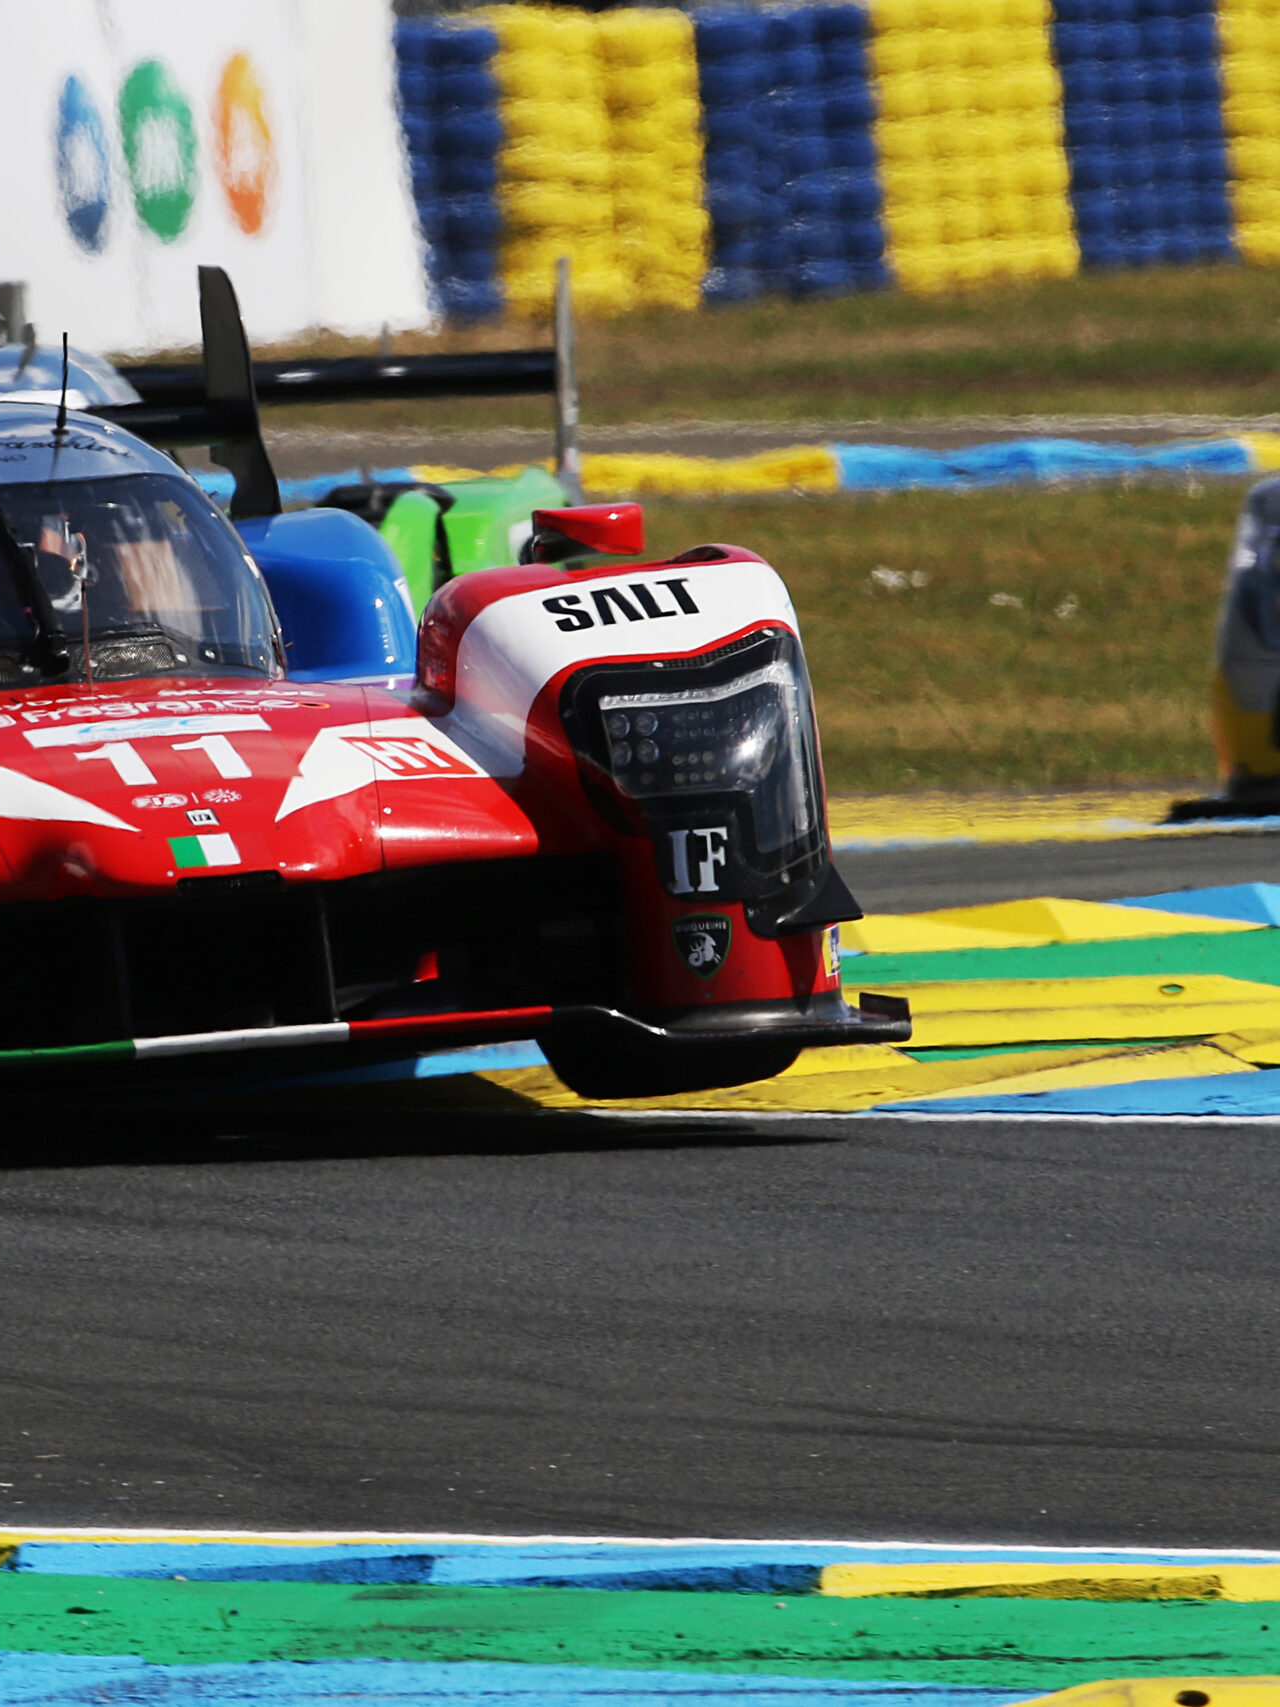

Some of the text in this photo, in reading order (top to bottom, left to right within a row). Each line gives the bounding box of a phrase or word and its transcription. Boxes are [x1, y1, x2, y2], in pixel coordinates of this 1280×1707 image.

[542, 578, 700, 632] SALT
[21, 699, 300, 723] Fragrance
[74, 735, 253, 786] 11
[352, 741, 452, 770] HY
[669, 826, 728, 894] IF
